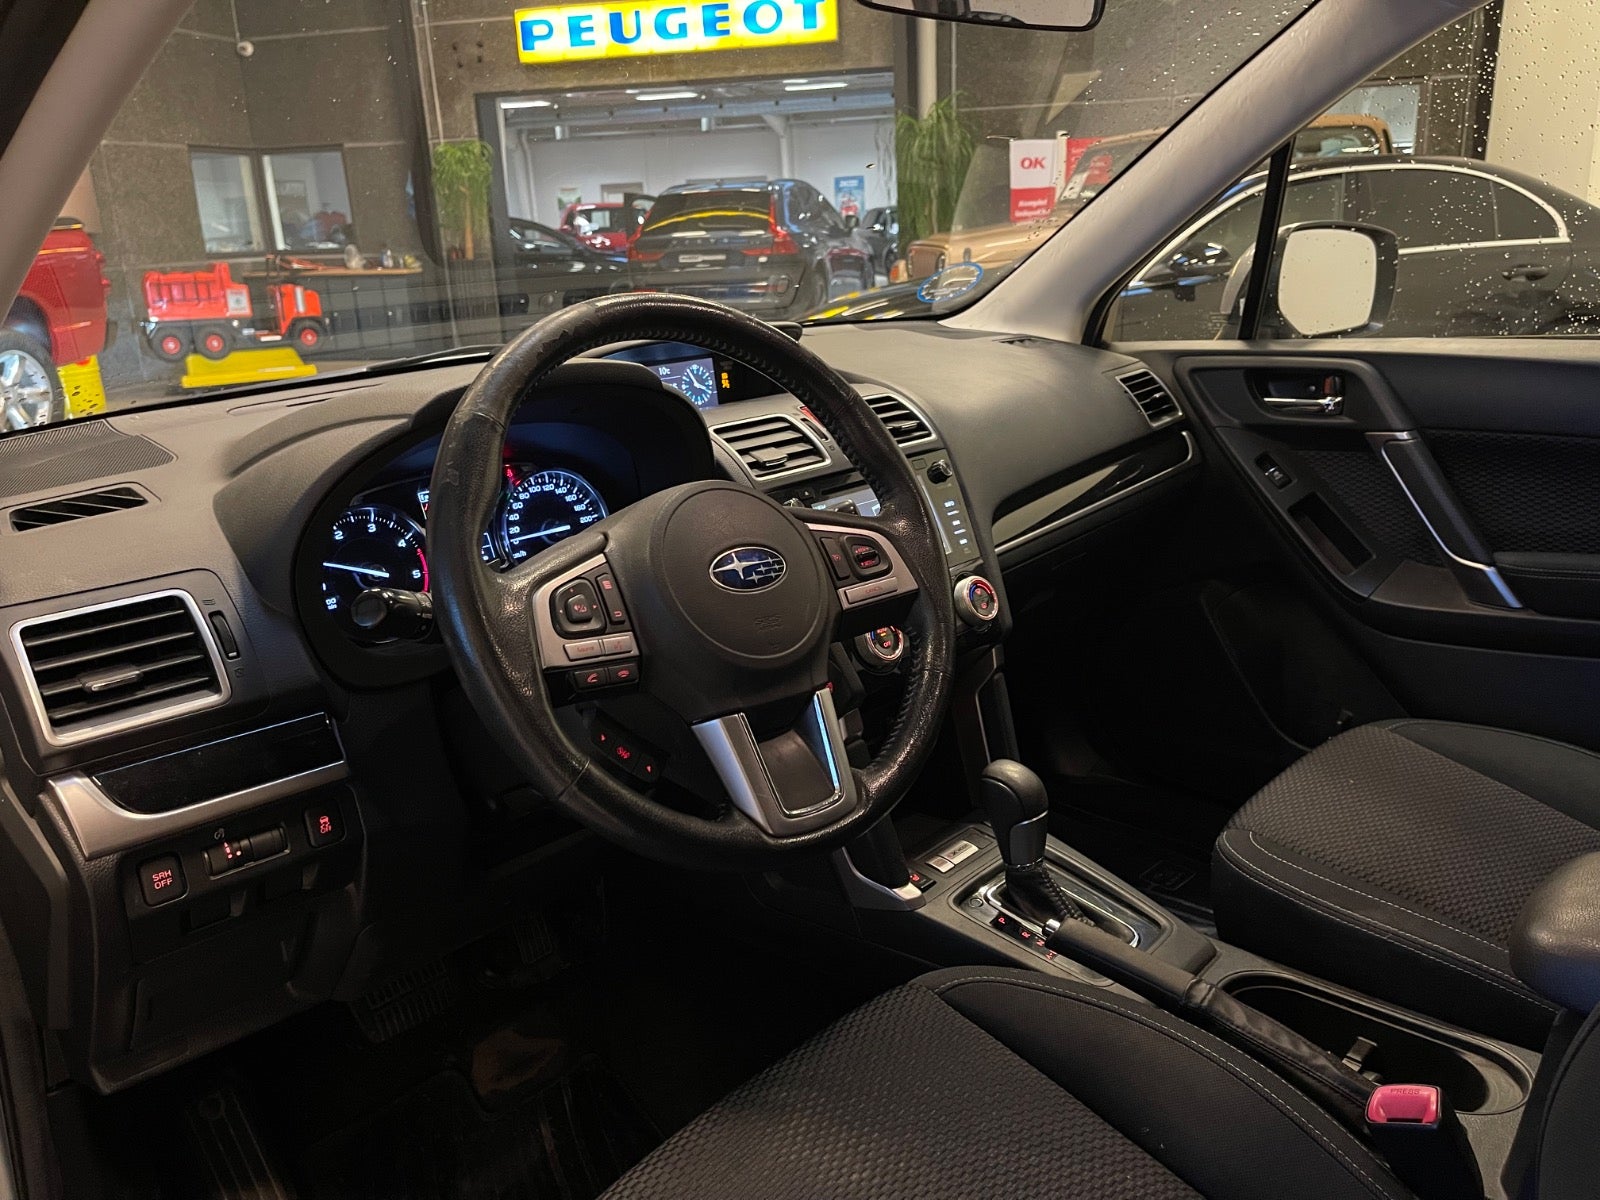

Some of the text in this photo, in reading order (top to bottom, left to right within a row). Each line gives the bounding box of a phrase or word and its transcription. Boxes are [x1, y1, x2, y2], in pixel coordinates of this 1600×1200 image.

[519, 0, 825, 51] PEUGEOT
[1020, 156, 1046, 170] OK
[528, 485, 541, 494] 100
[542, 483, 555, 491] 120
[555, 486, 567, 495] 140
[519, 492, 530, 500] 80
[565, 494, 577, 502] 160
[512, 502, 523, 510] 60
[574, 503, 586, 512] 180
[509, 513, 519, 521] 40
[580, 515, 593, 524] 200
[367, 523, 377, 533] 3
[508, 526, 520, 535] 20
[333, 530, 344, 540] 2
[397, 539, 407, 548] 4
[411, 569, 422, 579] 5
[152, 869, 172, 882] SRH
[154, 877, 173, 890] OFF
